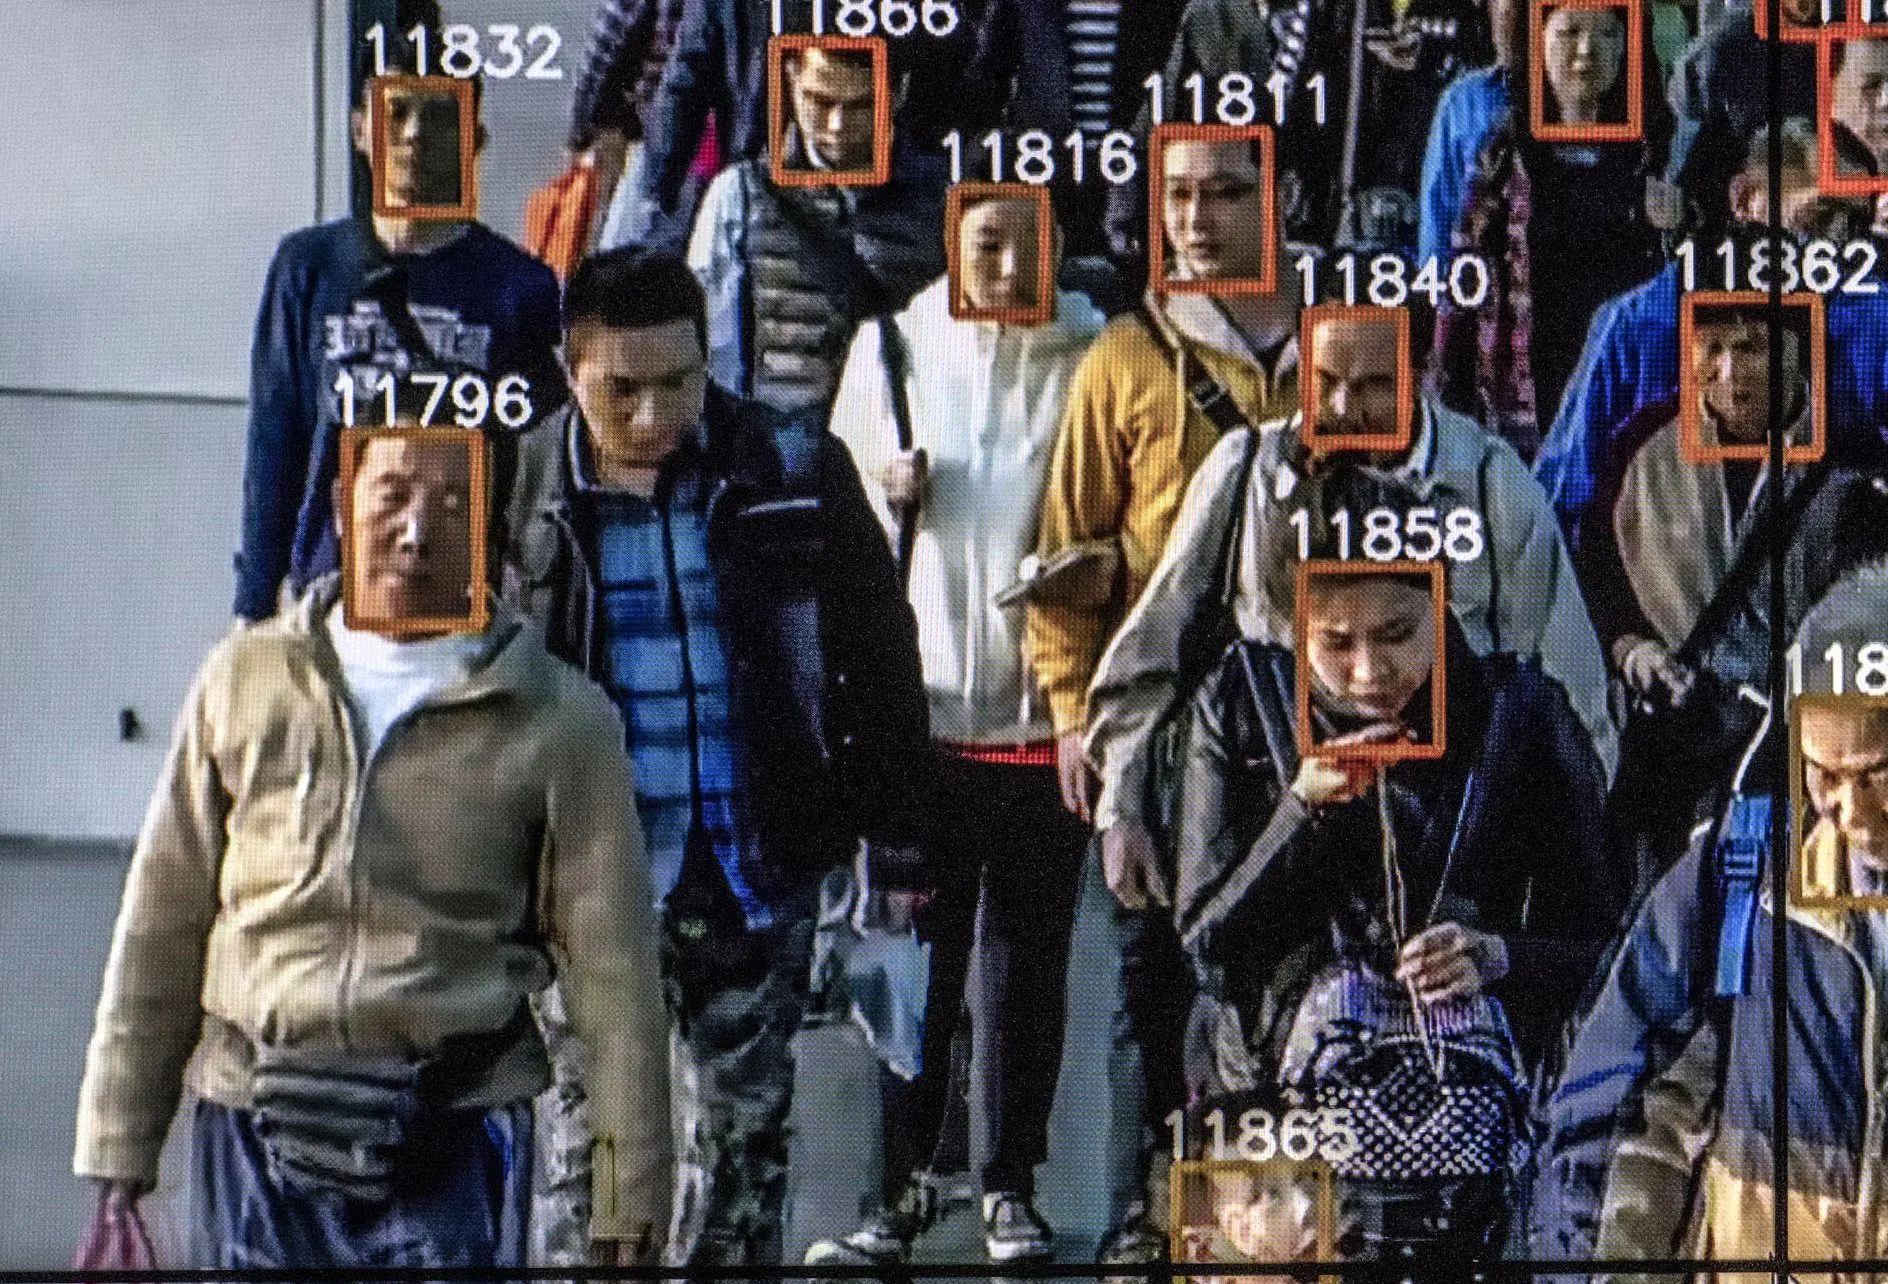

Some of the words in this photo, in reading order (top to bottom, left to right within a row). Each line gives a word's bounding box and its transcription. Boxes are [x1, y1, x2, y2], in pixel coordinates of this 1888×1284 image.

[365, 24, 565, 79] 11832
[1143, 73, 1330, 126] 11811
[942, 132, 1139, 185] 11816
[1295, 256, 1489, 307] 11840
[1676, 240, 1881, 294] 11862
[334, 373, 535, 428] 11796
[1290, 509, 1485, 562] 11858
[1164, 1110, 1361, 1162] 11865
